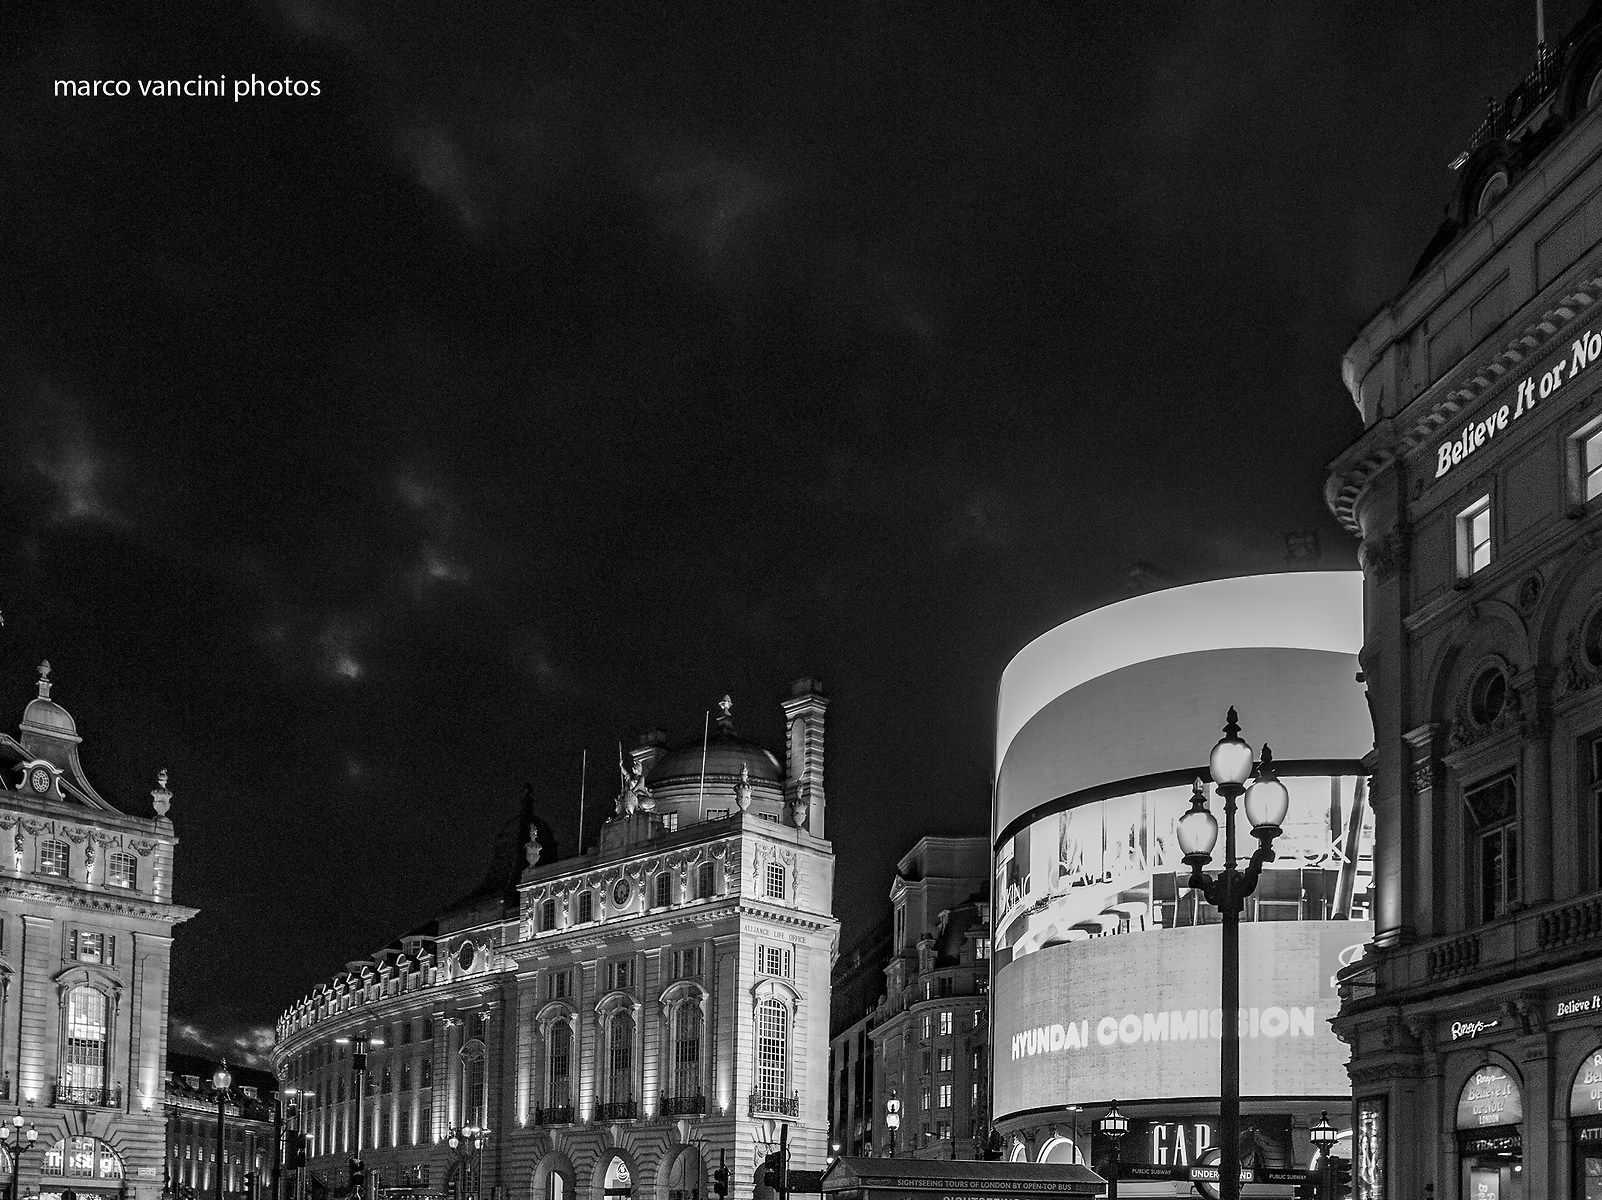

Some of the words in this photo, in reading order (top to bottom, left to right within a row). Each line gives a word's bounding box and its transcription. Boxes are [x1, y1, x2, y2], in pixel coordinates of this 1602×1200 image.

[1435, 404, 1510, 479] Believe
[1513, 376, 1536, 420] It
[1539, 359, 1567, 399] or
[1568, 329, 1602, 379] No
[743, 924, 769, 936] ALLIANCE
[773, 931, 785, 940] LIFE
[788, 934, 806, 943] OFFICE
[1556, 999, 1591, 1016] Believe
[1011, 1019, 1089, 1061] HYUNDAI
[1096, 1006, 1315, 1046] COMMISSION
[1468, 1087, 1501, 1101] Believe
[1153, 1123, 1211, 1166] GAP
[1466, 1136, 1522, 1151] ATTRACTION
[1191, 1169, 1252, 1180] UNDERND
[897, 1179, 943, 1188] SIGHTSEEING
[945, 1180, 968, 1188] TOURS
[969, 1181, 979, 1189] OF
[979, 1181, 1011, 1190] LONDON
[1012, 1182, 1022, 1190] BY
[1023, 1183, 1057, 1191] OPEN-TOP
